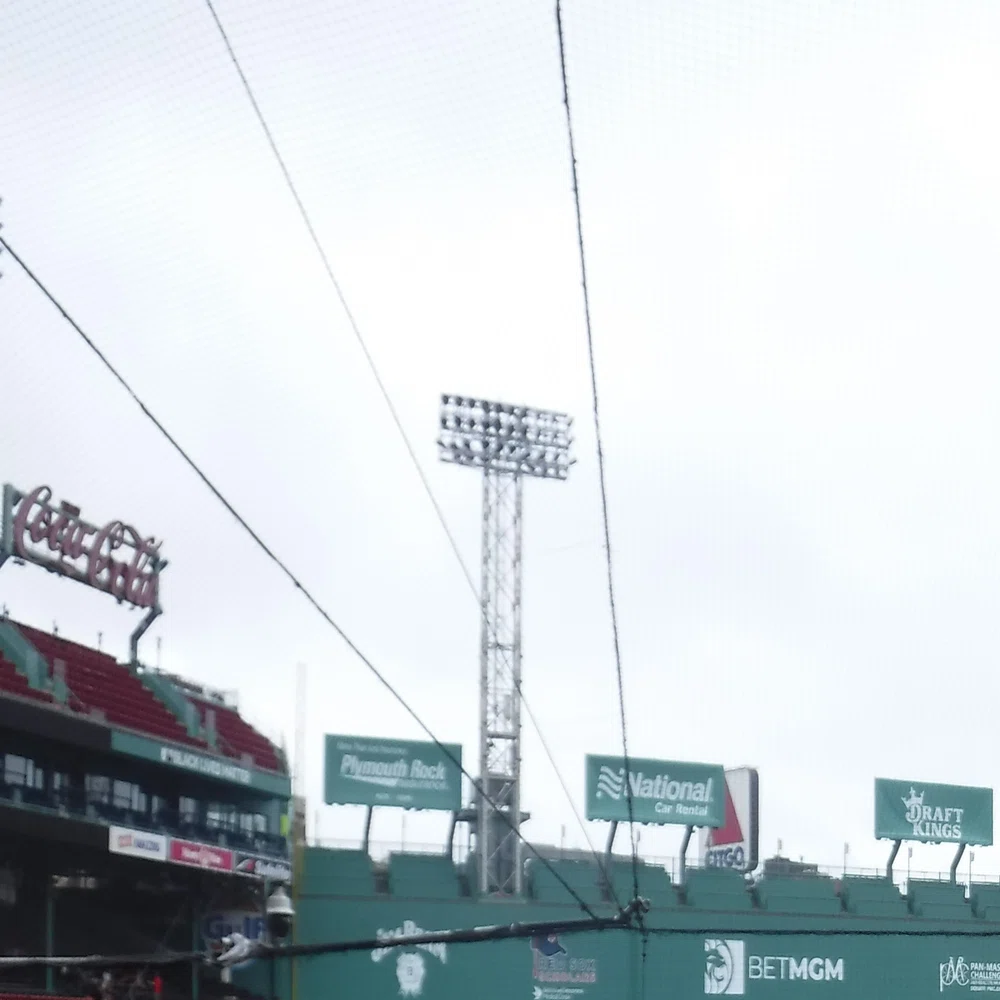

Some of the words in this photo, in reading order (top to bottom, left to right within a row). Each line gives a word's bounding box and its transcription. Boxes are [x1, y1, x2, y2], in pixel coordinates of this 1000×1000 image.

[410, 759, 445, 780] Rock
[624, 771, 713, 802] National
[655, 802, 671, 813] Car
[675, 803, 708, 817] Rental
[905, 802, 964, 823] DRAFT
[912, 820, 962, 839] KINGS
[705, 846, 745, 868] CITGO
[748, 955, 844, 981] BETMGM
